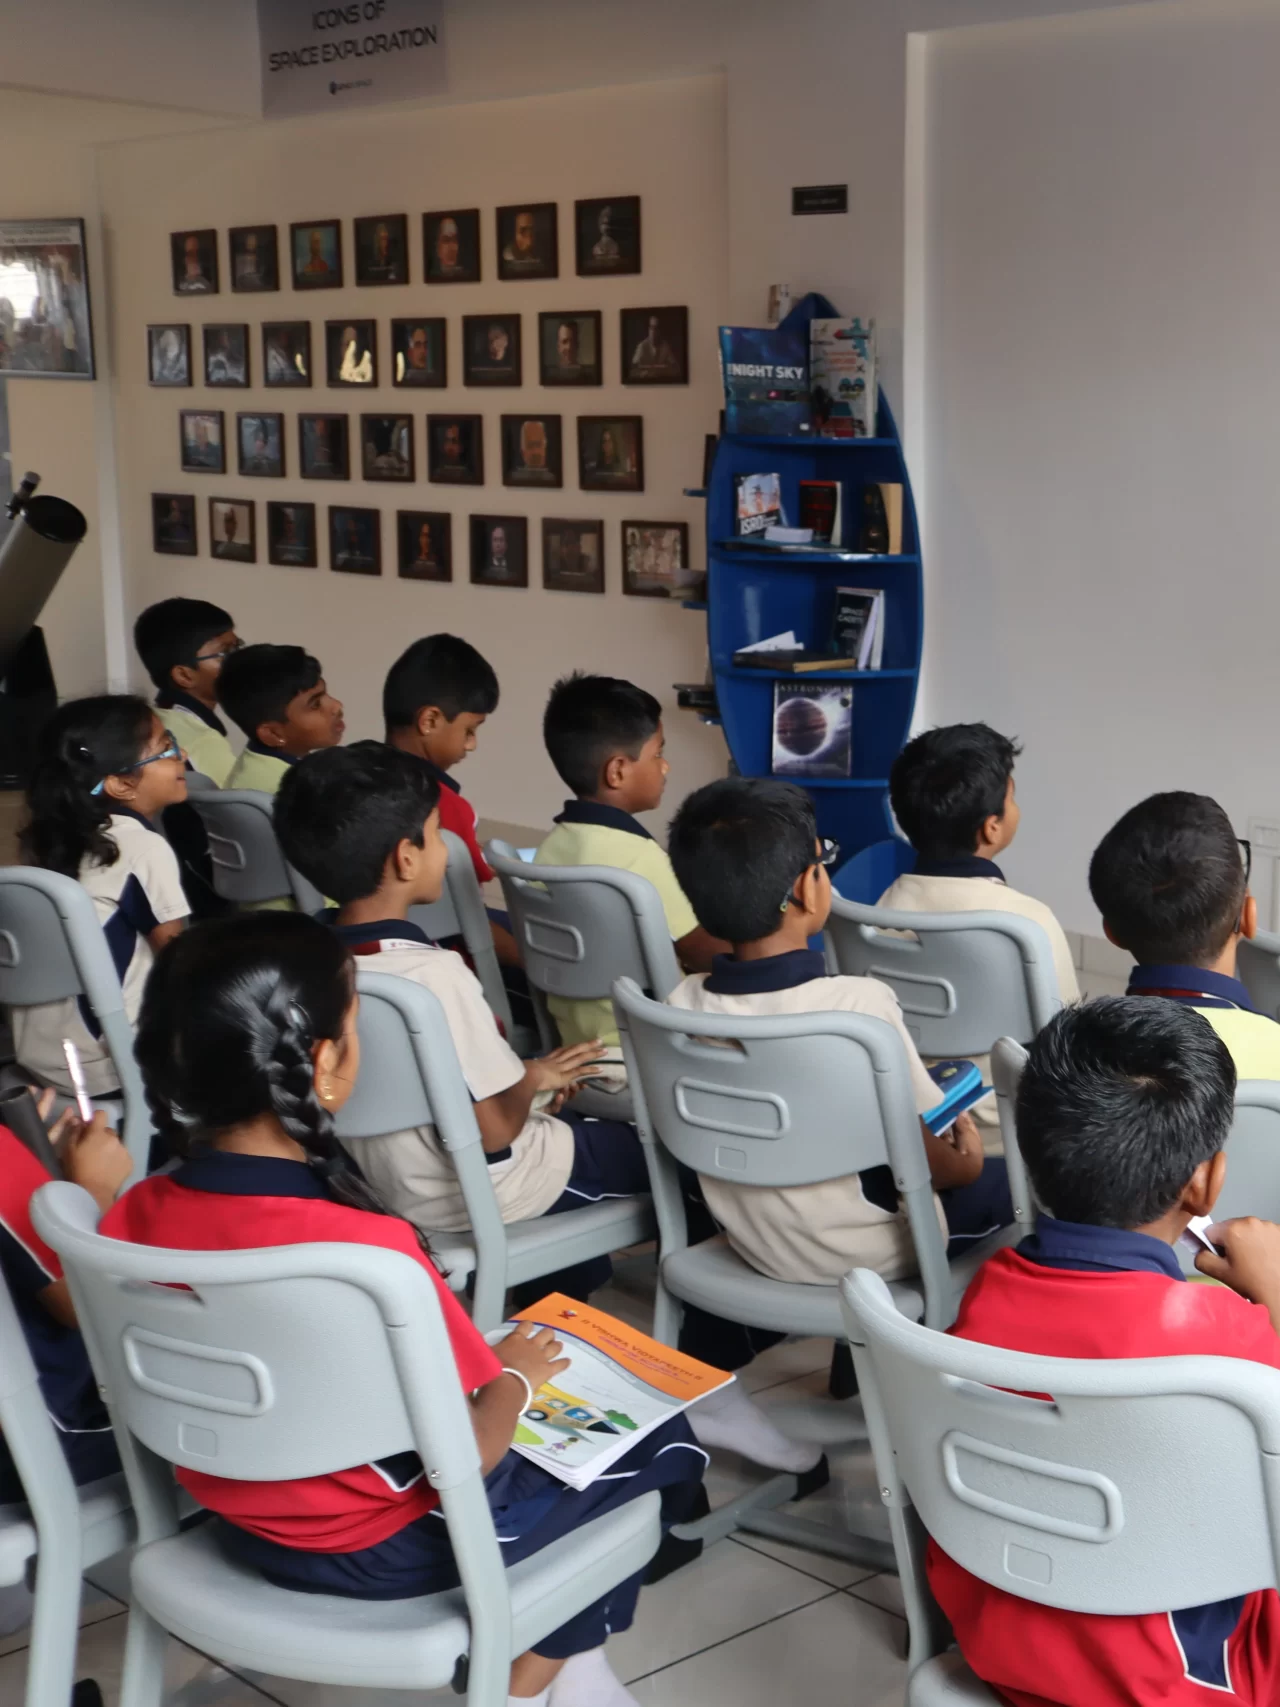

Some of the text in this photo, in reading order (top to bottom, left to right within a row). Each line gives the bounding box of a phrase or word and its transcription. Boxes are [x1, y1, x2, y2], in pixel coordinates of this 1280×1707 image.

[312, 0, 386, 30] ICONS OF
[269, 24, 438, 72] SPACE EXPLORATION
[731, 363, 774, 378] NIGHT
[775, 366, 804, 379] SKY
